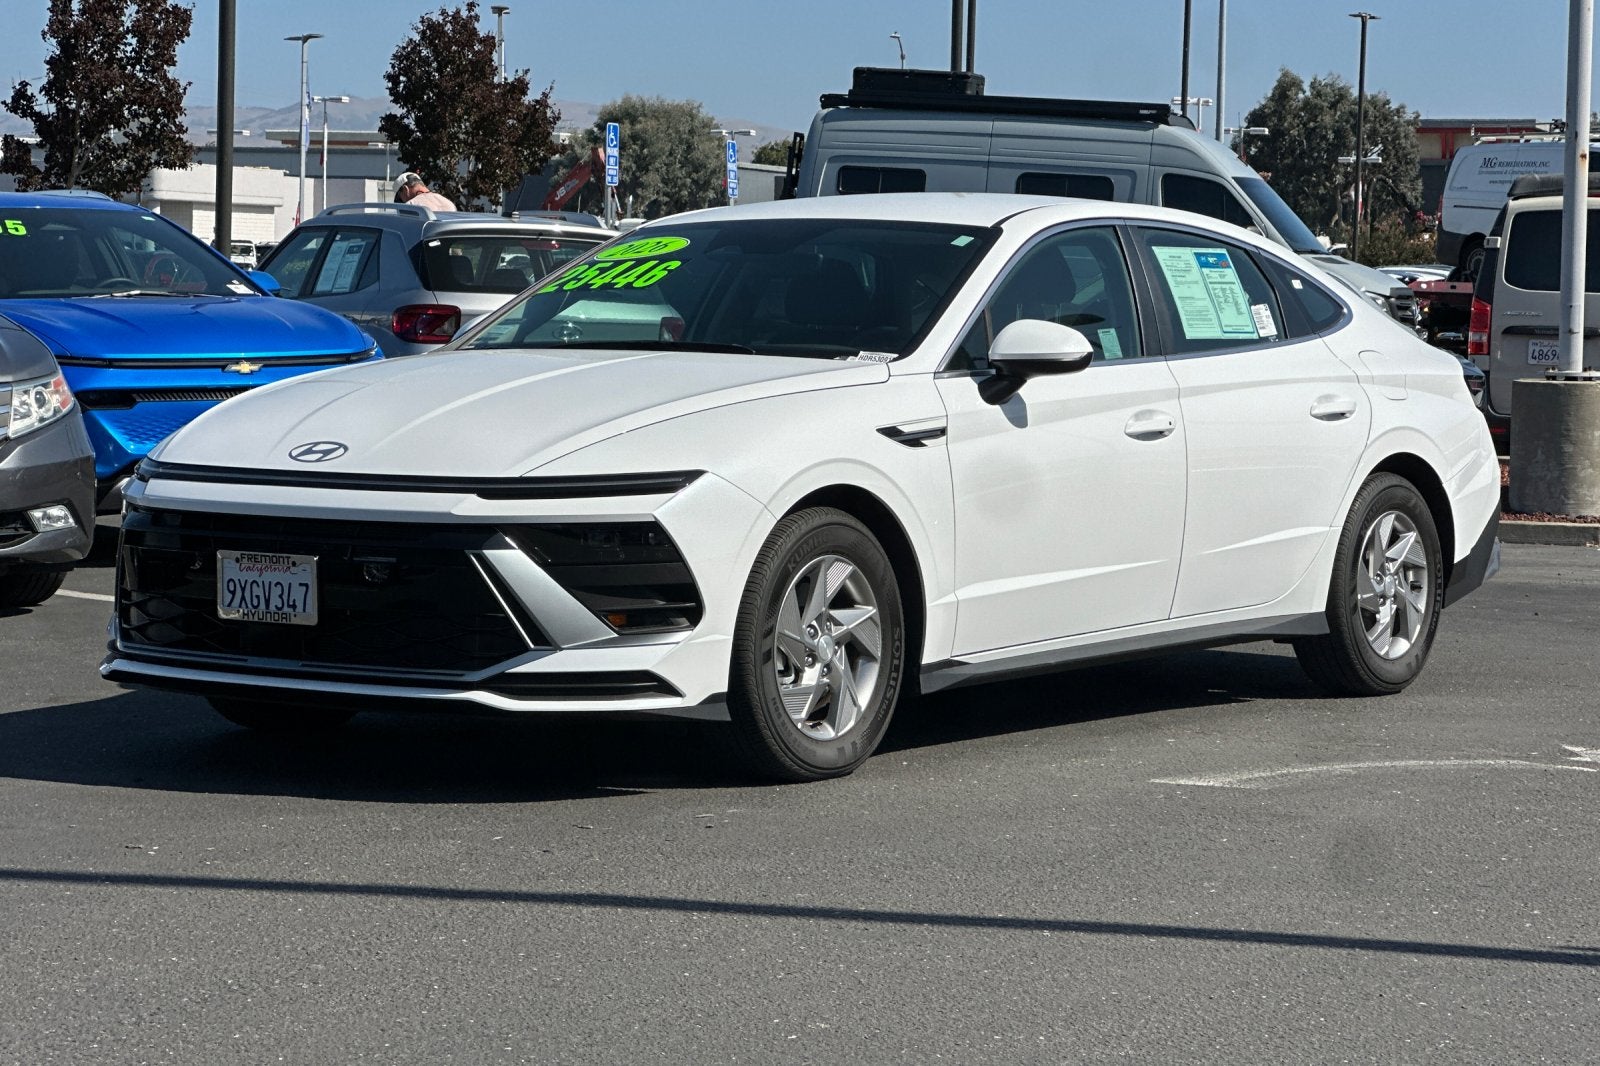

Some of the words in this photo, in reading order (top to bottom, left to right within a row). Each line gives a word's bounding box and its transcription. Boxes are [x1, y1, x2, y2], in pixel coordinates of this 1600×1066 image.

[1480, 157, 1498, 168] MG
[0, 219, 27, 236] 5
[537, 260, 682, 294] 25446
[240, 553, 291, 565] FREMONT
[239, 563, 296, 577] California
[226, 578, 310, 613] 9XGV347
[242, 608, 292, 622] HYUNDAI
